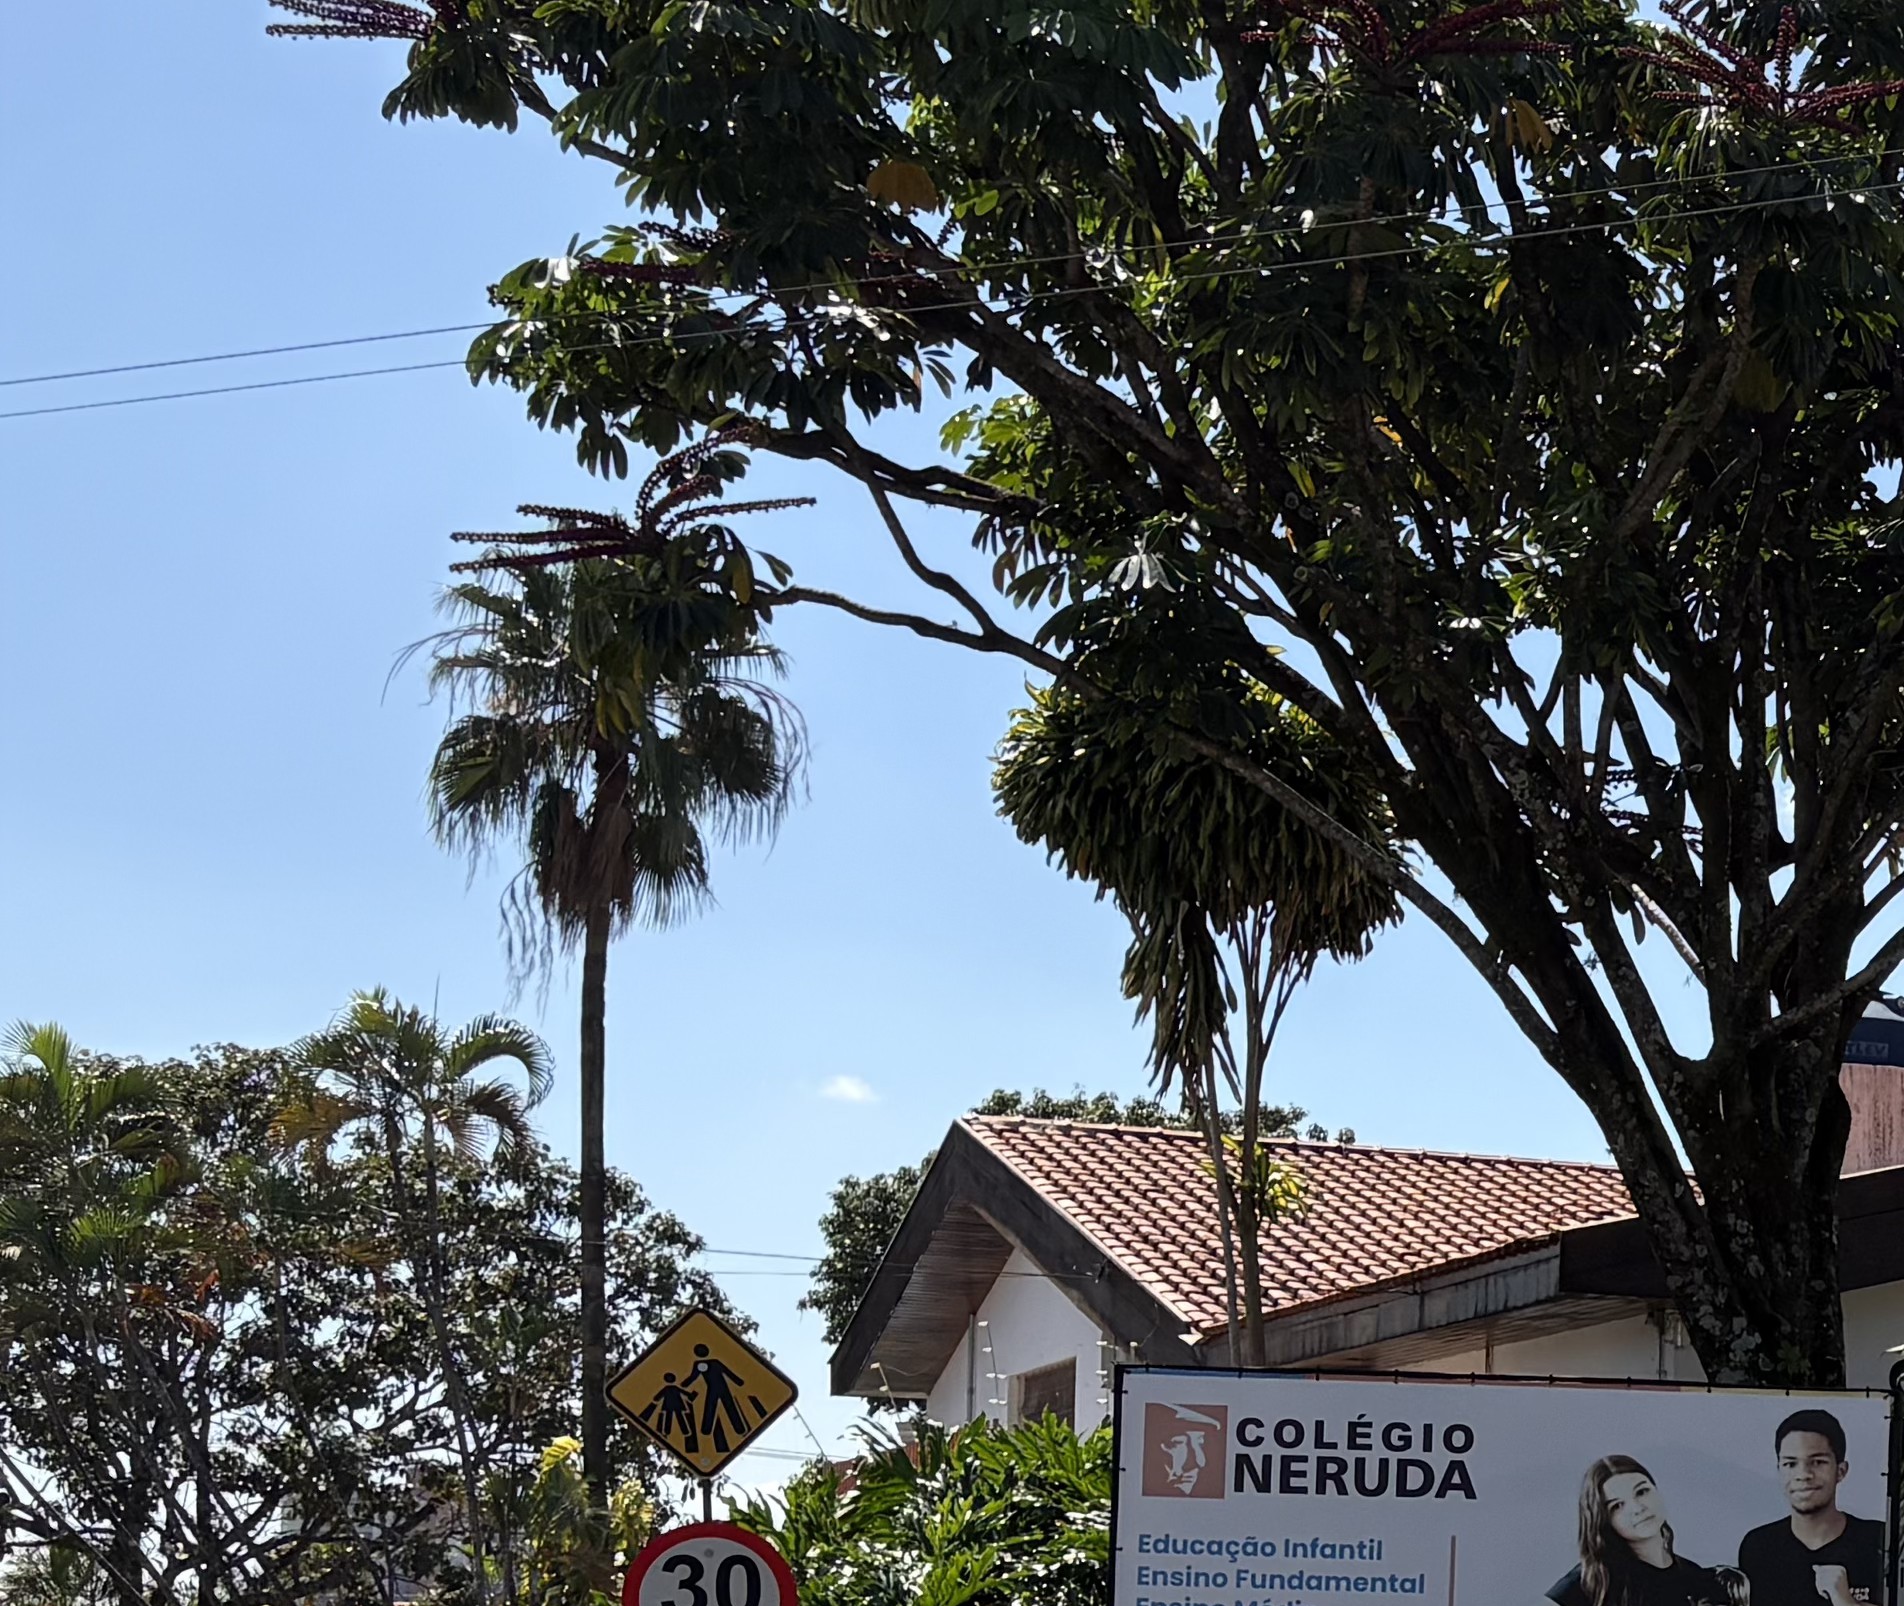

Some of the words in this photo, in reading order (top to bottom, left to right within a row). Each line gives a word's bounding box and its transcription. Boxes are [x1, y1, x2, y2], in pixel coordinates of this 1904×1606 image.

[1235, 1413, 1475, 1454] COLÉGIO
[1233, 1453, 1478, 1500] NERUDA
[1138, 1534, 1277, 1563] Educação
[1284, 1537, 1383, 1561] Infantil
[1136, 1566, 1228, 1589] Ensino
[1236, 1569, 1425, 1594] Fundamental
